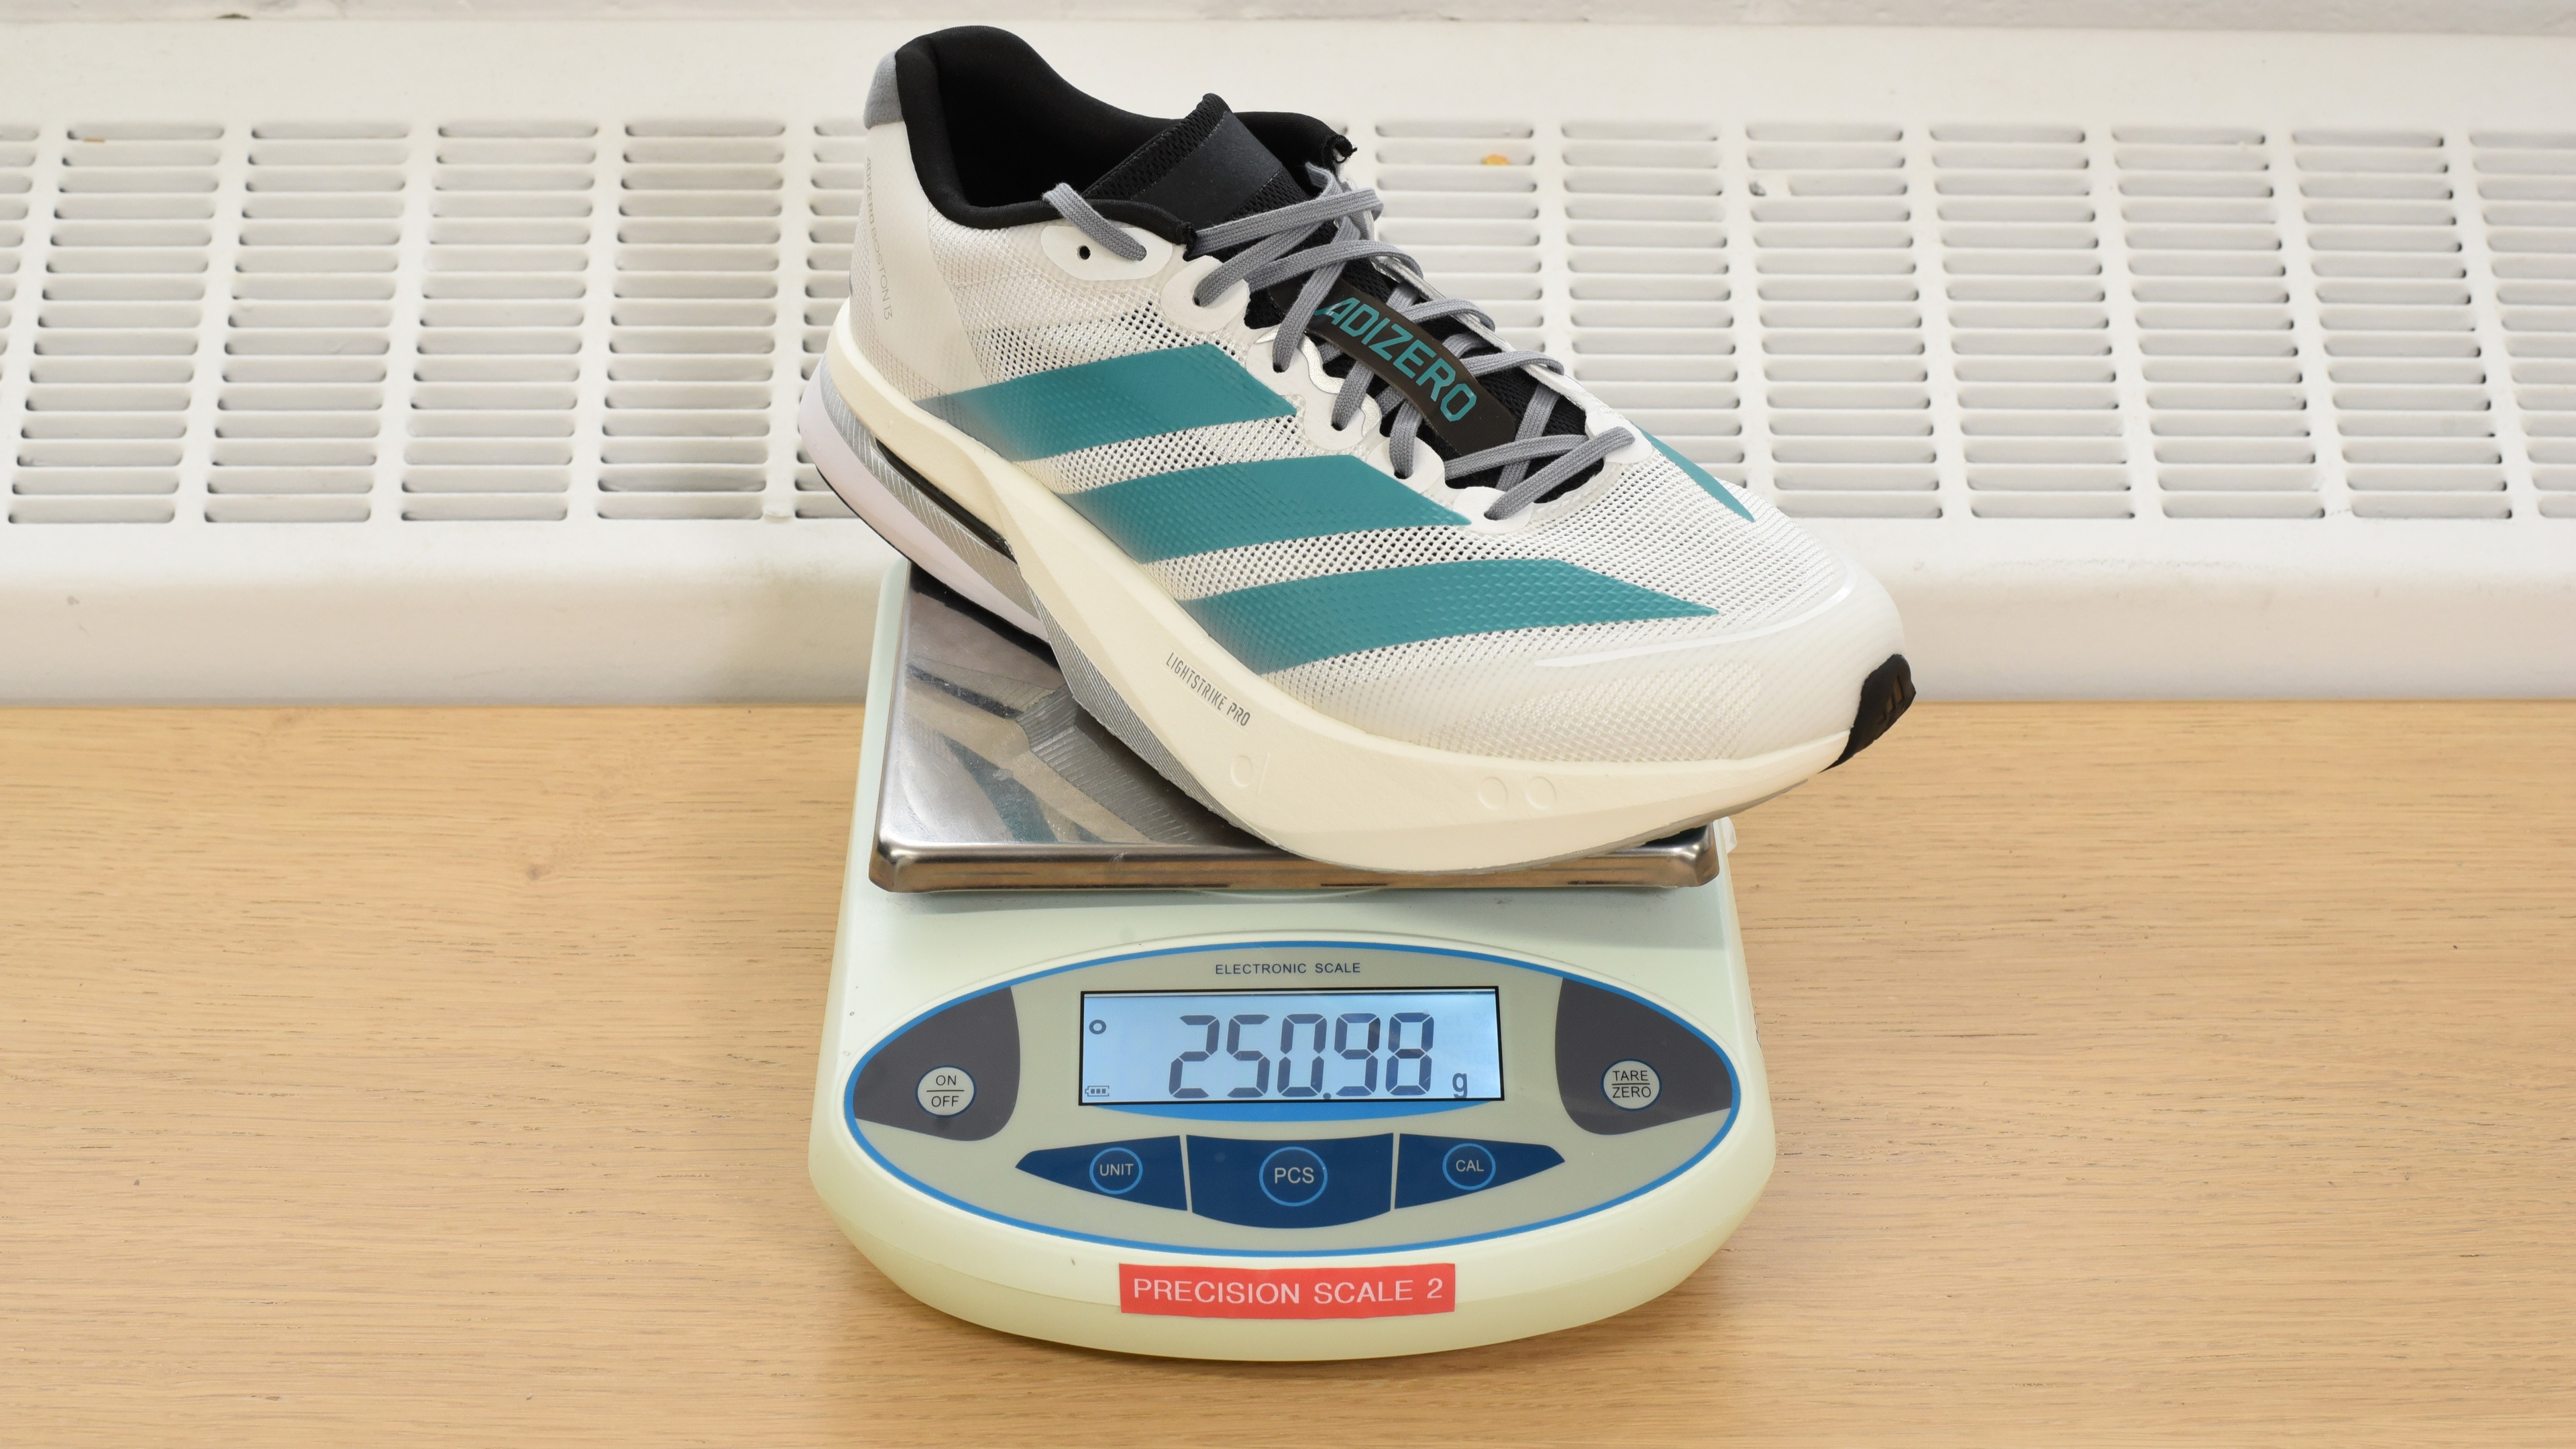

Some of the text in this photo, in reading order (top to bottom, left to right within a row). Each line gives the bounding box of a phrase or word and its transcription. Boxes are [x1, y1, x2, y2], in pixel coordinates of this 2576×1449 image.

[871, 227, 890, 302] BOSTON
[883, 305, 893, 320] 13
[1313, 297, 1477, 422] ADIZERO
[1166, 652, 1251, 727] LIGHTSTRIKE PRO
[1216, 962, 1361, 975] ELECTRONIC SCALE
[1169, 1012, 1435, 1099] 250.98
[1452, 1072, 1468, 1099] g
[936, 1075, 957, 1086] ON
[1612, 1070, 1649, 1081] TARE
[1612, 1086, 1652, 1098] ZERO
[931, 1095, 959, 1108] OFF
[1100, 1163, 1134, 1177] UNIT
[1456, 1159, 1485, 1172] CAL
[1275, 1167, 1315, 1184] PCS
[1134, 1277, 1443, 1304] PRECISION SCALE 2
